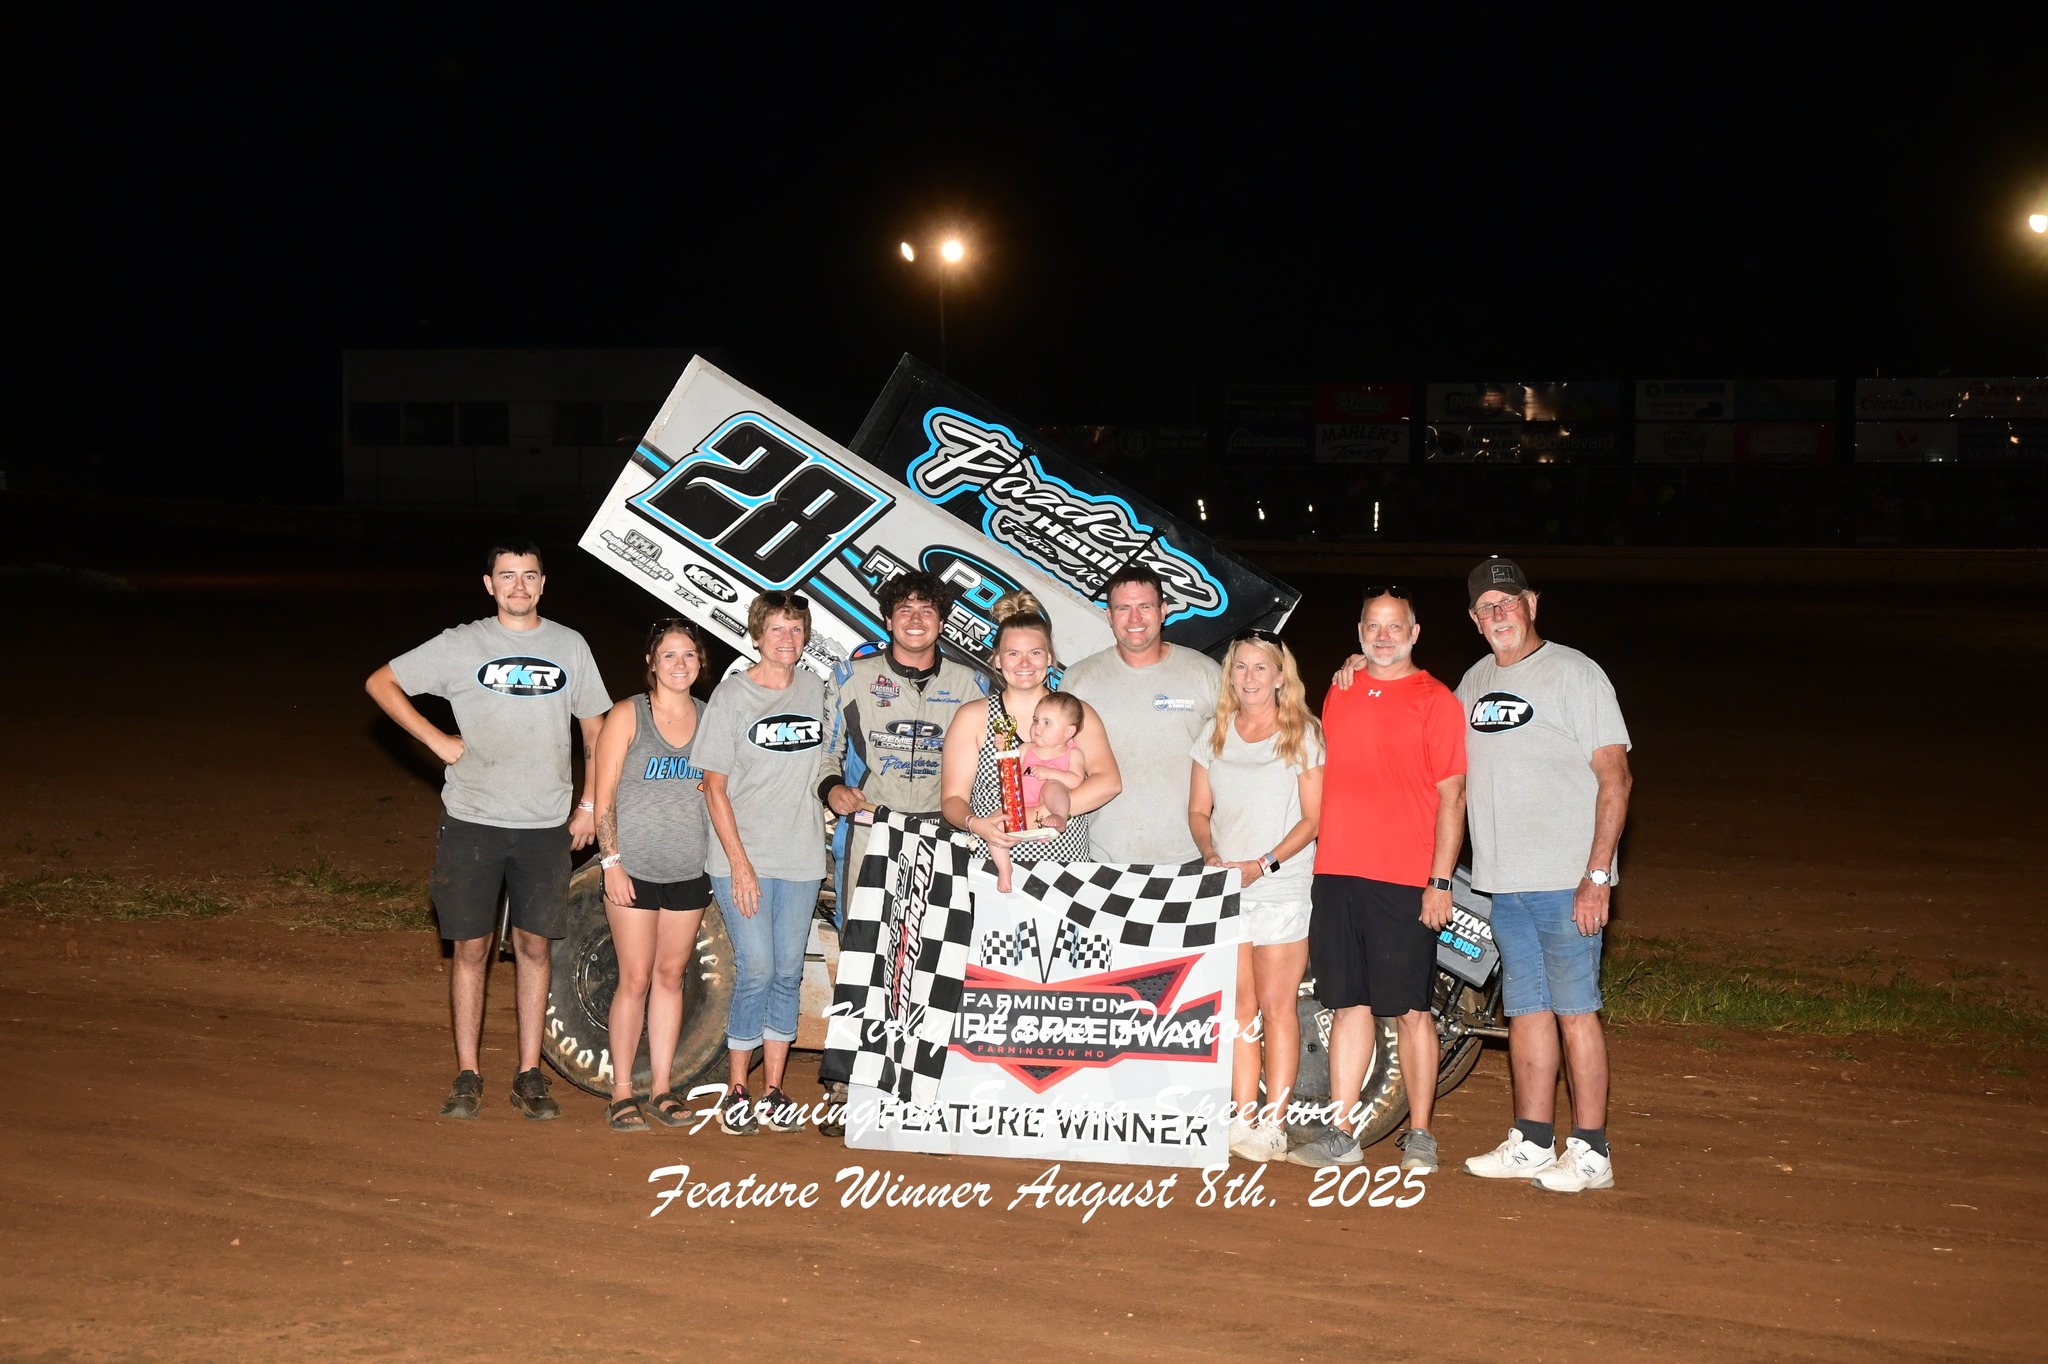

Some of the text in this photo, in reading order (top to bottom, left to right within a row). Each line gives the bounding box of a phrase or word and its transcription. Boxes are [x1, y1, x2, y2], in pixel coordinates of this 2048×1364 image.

[1909, 398, 1953, 411] LIGHT
[1321, 426, 1402, 444] MARLER'S
[1472, 428, 1513, 438] ANYTIME
[626, 411, 895, 590] 28
[685, 564, 736, 600] KKR
[938, 560, 1005, 610] PD
[483, 664, 561, 687] KKR
[1471, 700, 1529, 723] KKR
[755, 720, 821, 744] KKR
[906, 841, 933, 938] Kirby
[963, 992, 1125, 1013] FARMINGTON
[1013, 1015, 1206, 1049] SPEEDWAY
[977, 1045, 1105, 1058] FARMINGTON MO
[878, 1102, 1209, 1148] FEATURE WINNER
